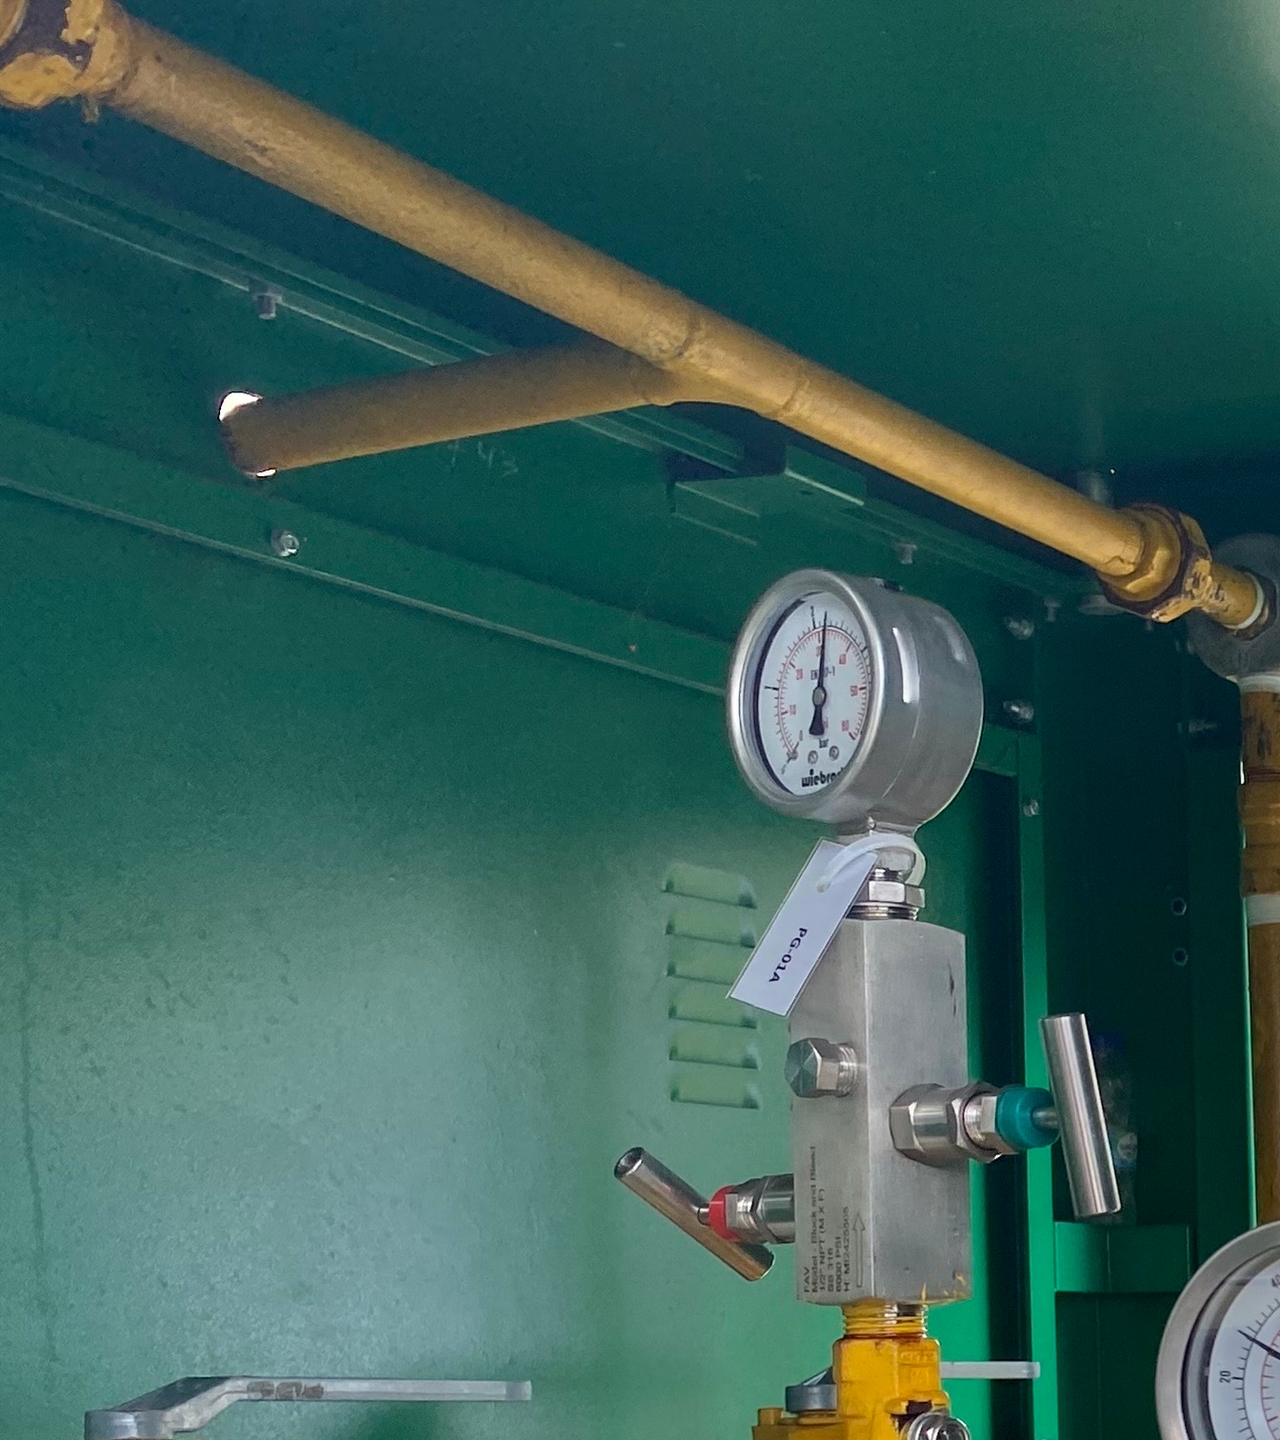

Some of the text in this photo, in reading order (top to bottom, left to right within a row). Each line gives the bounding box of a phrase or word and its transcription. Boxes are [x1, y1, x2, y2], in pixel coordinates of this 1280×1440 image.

[801, 767, 844, 788] wiebro
[768, 927, 808, 983] PG-01A
[1219, 1370, 1232, 1384] 20
